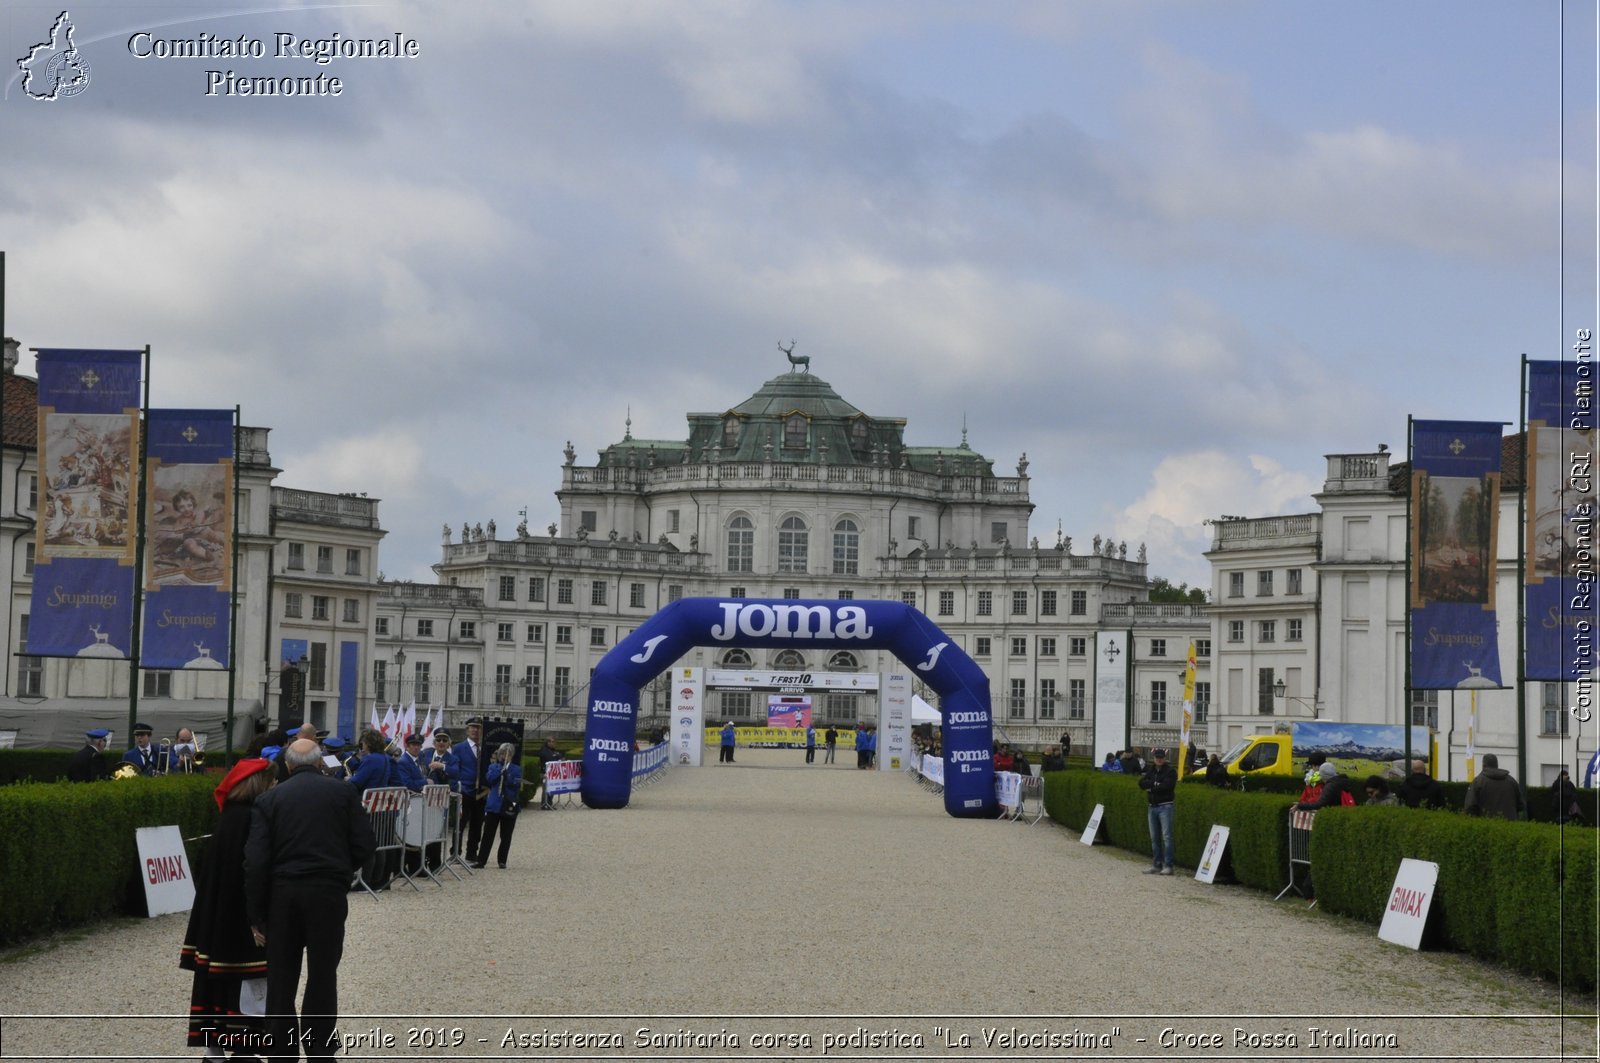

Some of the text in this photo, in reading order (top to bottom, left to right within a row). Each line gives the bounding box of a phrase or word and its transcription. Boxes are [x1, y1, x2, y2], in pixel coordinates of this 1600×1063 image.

[46, 585, 117, 608] Stupinigi
[157, 608, 217, 628] Stupinigi
[1424, 627, 1484, 647] Stupinigi
[146, 855, 187, 885] GIMAX
[1390, 886, 1426, 918] GIMAX
